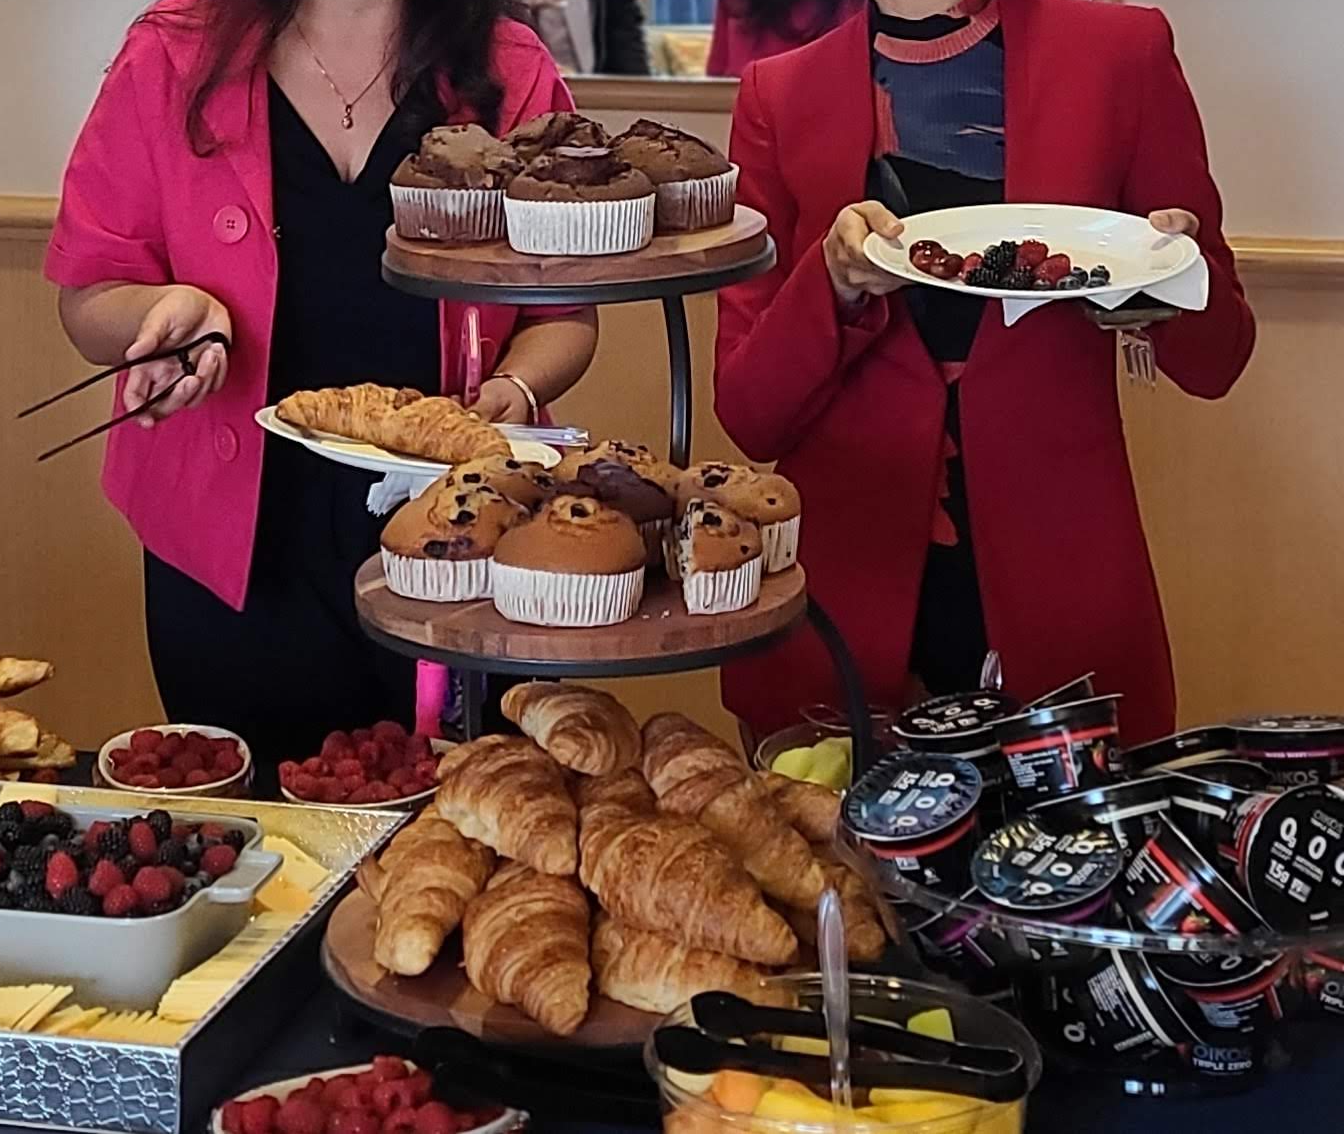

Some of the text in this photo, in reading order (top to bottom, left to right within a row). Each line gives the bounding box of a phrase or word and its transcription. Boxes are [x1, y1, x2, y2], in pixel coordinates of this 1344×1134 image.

[1307, 835, 1327, 860] 0
[1267, 858, 1291, 884] 15g
[1192, 1057, 1253, 1071] TRIPLE ZERO
